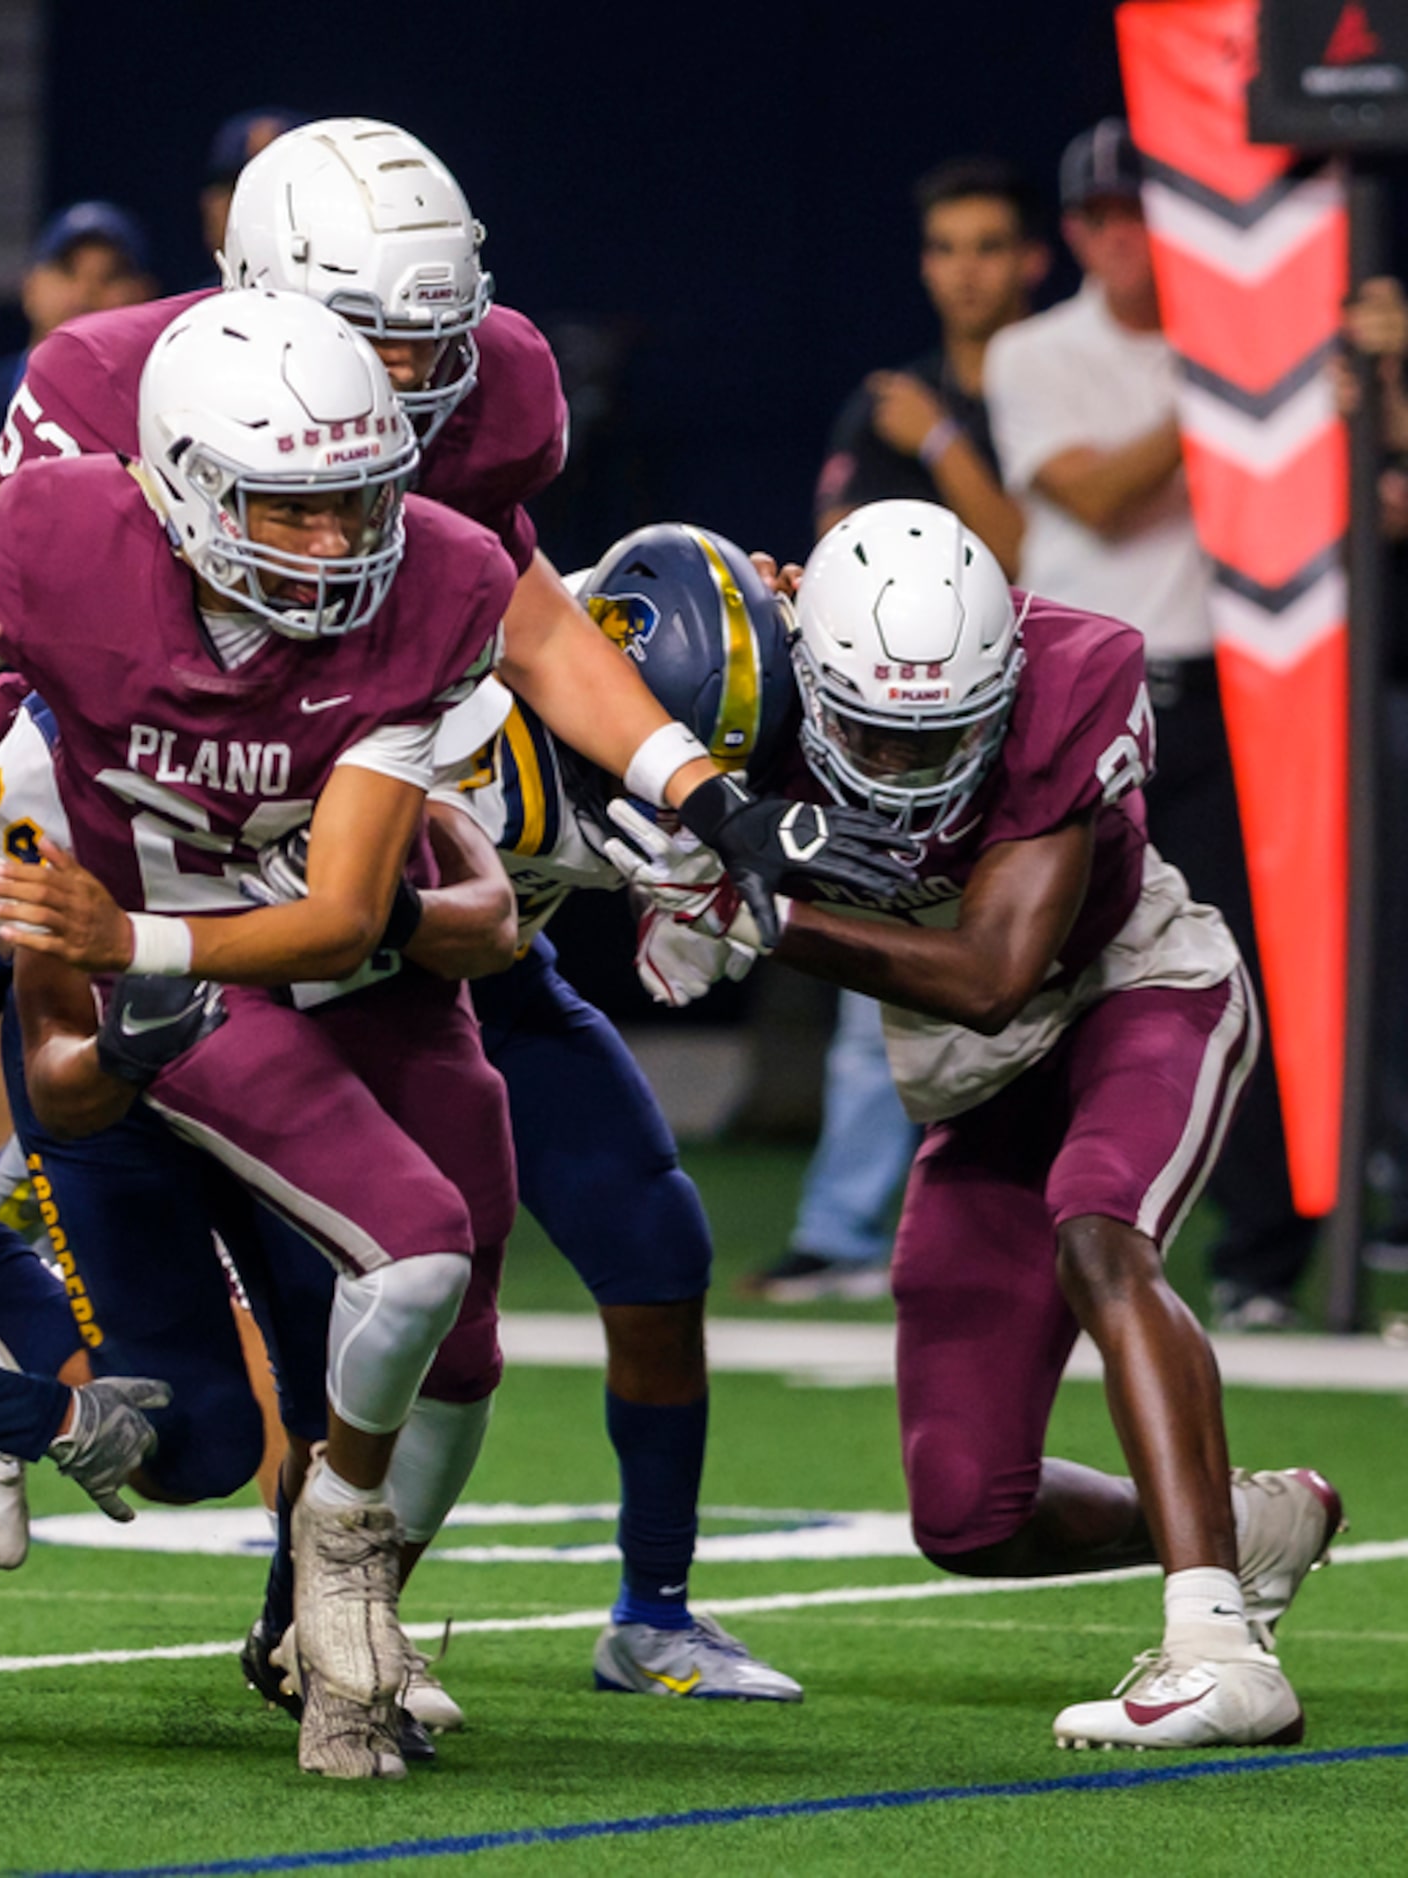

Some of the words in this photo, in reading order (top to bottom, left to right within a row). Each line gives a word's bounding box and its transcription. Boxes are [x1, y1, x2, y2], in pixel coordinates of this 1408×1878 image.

[331, 446, 370, 463] PLANO
[901, 689, 942, 702] PLANO
[127, 723, 291, 796] PLANO
